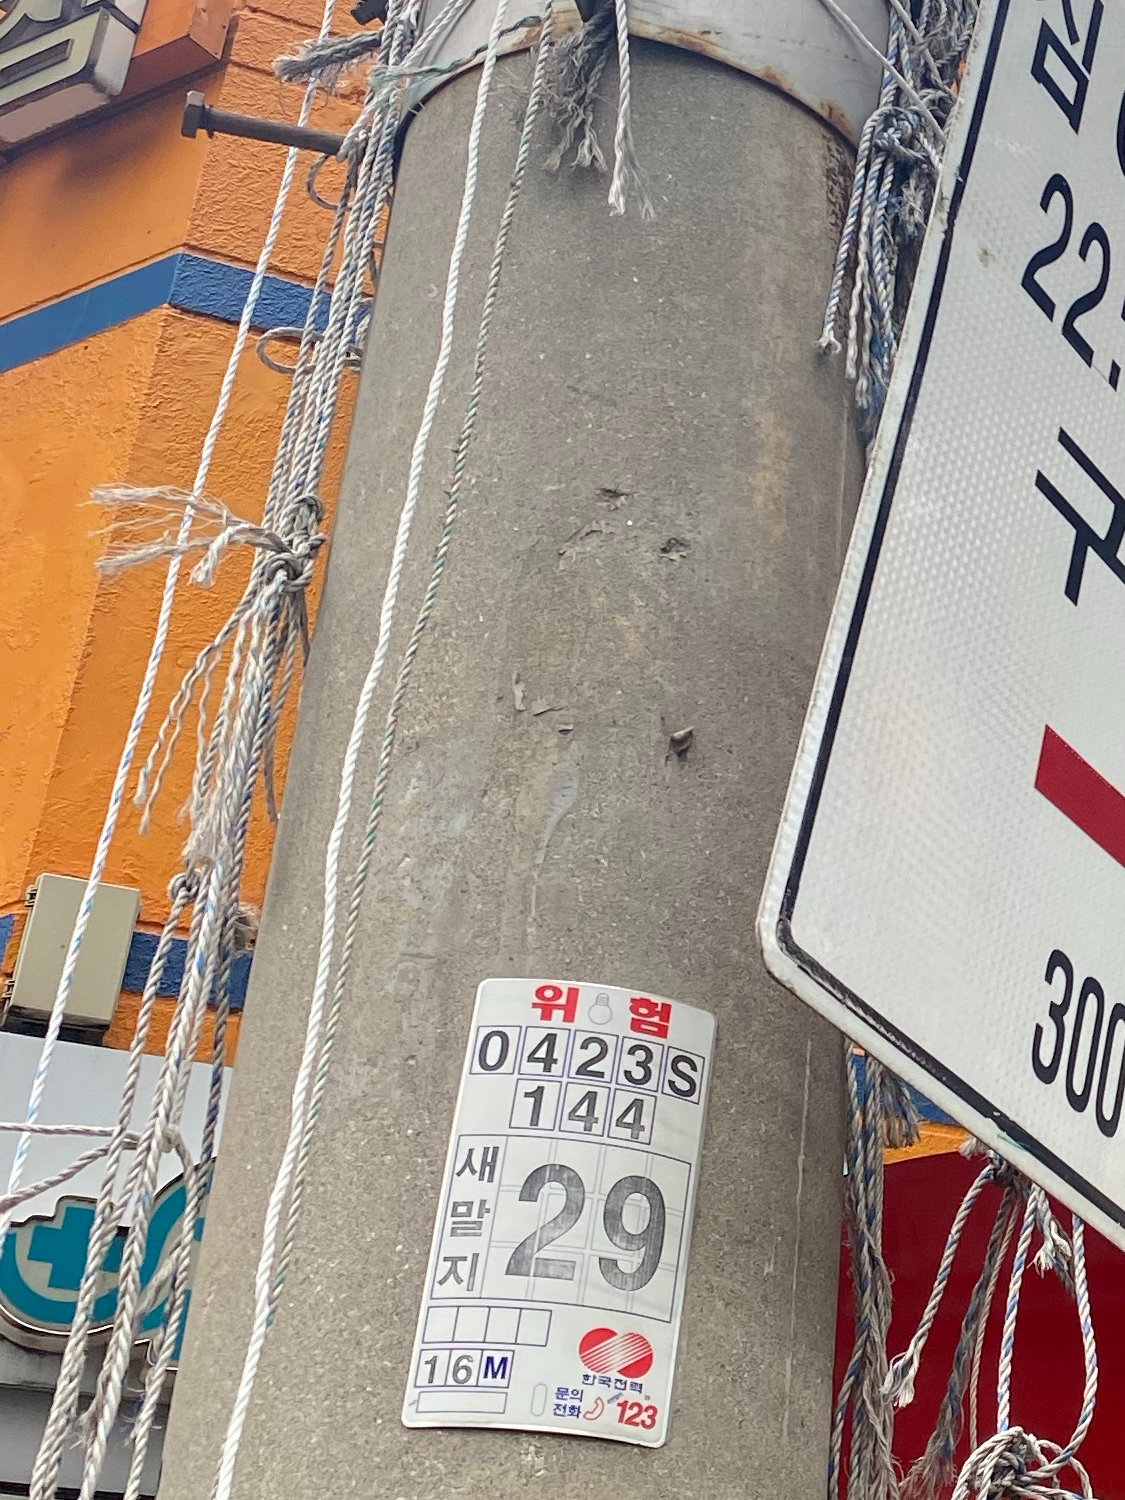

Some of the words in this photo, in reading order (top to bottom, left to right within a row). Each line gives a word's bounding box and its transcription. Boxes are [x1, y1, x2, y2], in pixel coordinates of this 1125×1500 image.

[522, 1085, 645, 1141] 144
[436, 1146, 498, 1293] 새말지
[505, 1163, 667, 1292] 29
[554, 1386, 584, 1402] 문의
[581, 1373, 643, 1394] 한국전력
[552, 1403, 581, 1419] 전화
[616, 1400, 658, 1430] 123
